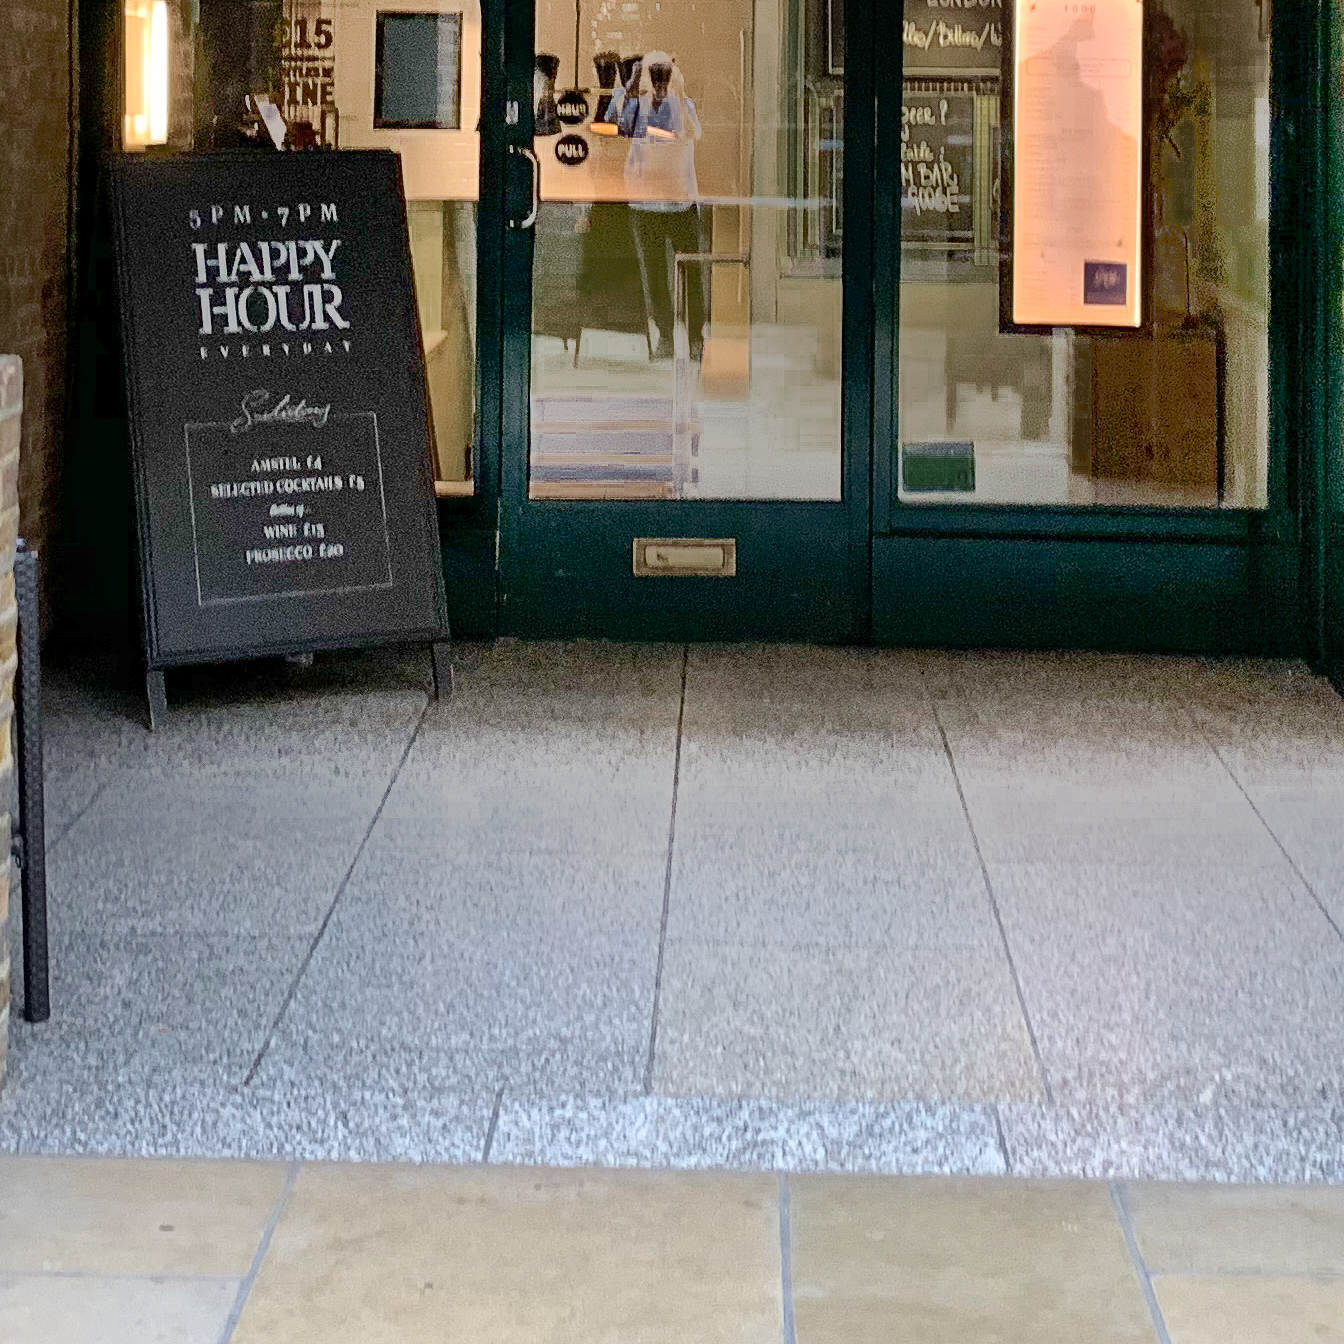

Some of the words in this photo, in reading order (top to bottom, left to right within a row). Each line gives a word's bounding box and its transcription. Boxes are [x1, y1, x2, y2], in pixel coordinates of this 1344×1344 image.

[558, 143, 585, 157] PULL
[191, 239, 342, 283] HAPPY
[195, 283, 350, 334] HOUR
[263, 524, 297, 539] WINE
[245, 546, 313, 565] PROSECCO
